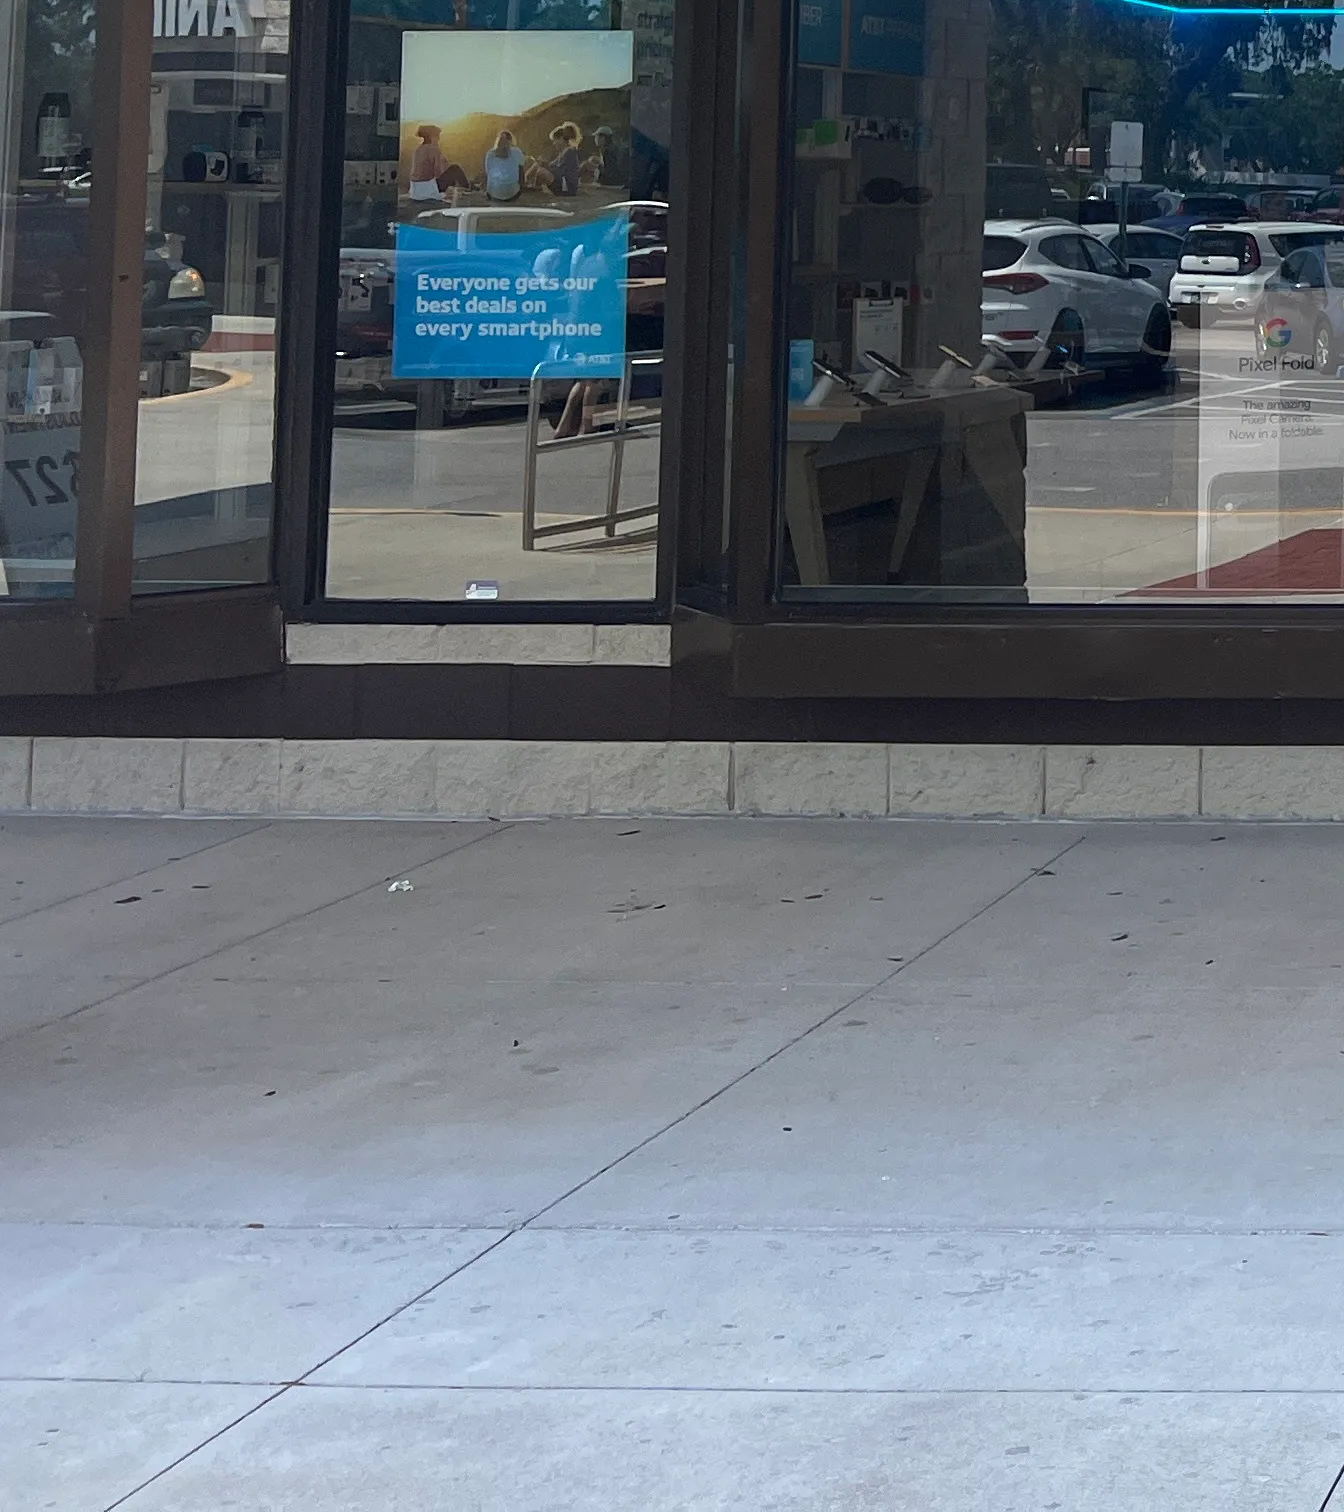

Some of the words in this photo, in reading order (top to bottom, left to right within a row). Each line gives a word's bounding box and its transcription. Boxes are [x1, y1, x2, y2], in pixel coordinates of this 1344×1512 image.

[417, 274, 511, 295] Everyone
[515, 275, 559, 294] gets
[564, 277, 597, 291] our
[416, 296, 460, 313] best
[465, 296, 517, 313] deals
[522, 300, 547, 313] on
[415, 322, 473, 340] every
[478, 319, 602, 340] smartphone
[1239, 356, 1277, 371] Pixel
[1282, 355, 1315, 370] Fold
[1243, 400, 1264, 410] The
[1267, 400, 1311, 411] amazing
[1241, 414, 1267, 425] Pixel
[1229, 430, 1255, 440] Now
[1258, 429, 1269, 439] in
[1271, 429, 1278, 438] a
